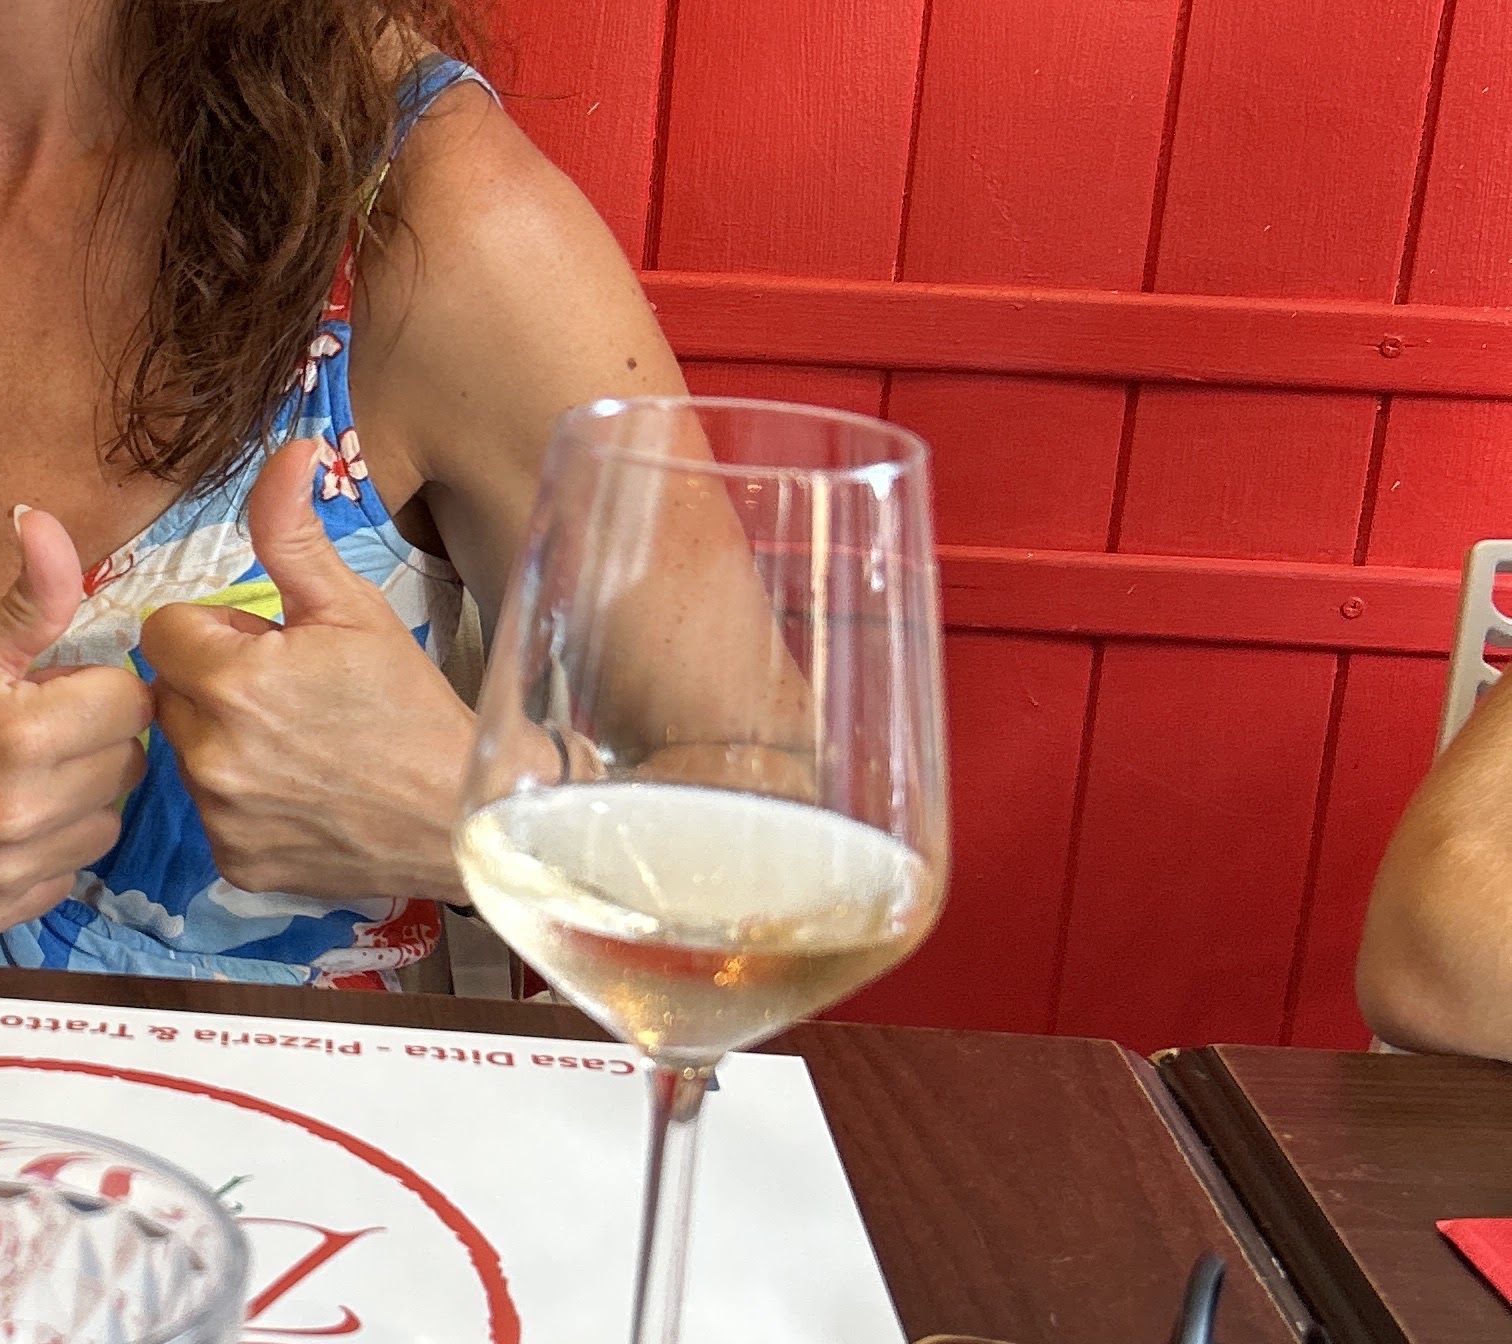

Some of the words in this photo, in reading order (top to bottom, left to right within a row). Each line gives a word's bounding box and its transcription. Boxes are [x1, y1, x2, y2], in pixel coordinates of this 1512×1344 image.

[148, 1025, 181, 1042] &
[192, 1028, 364, 1057] Pizzeria
[402, 1045, 518, 1068] Ditta
[530, 1054, 638, 1076] Casa
